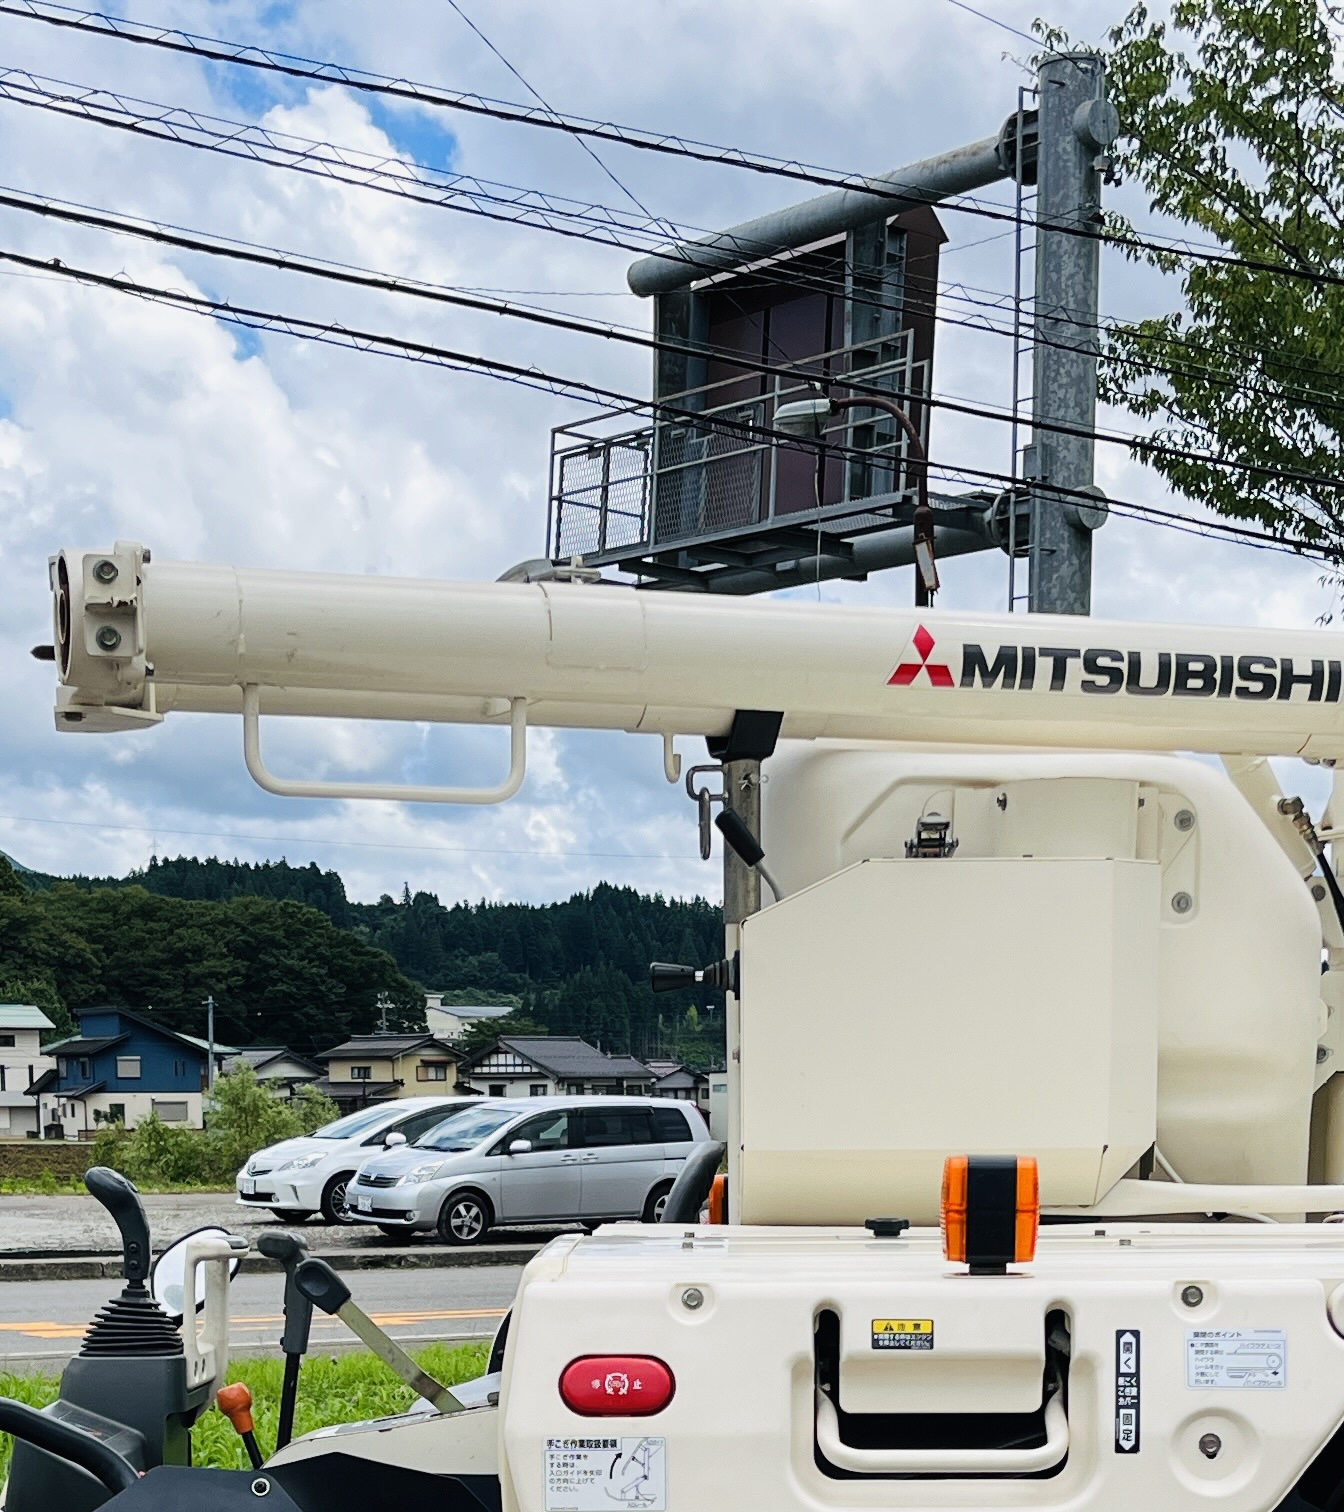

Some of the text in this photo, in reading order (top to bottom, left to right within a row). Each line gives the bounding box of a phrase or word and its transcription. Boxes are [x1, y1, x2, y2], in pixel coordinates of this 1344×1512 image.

[959, 643, 1343, 704] MITSUBISHI
[1122, 1341, 1133, 1370] 開く
[1122, 1413, 1133, 1442] 固定
